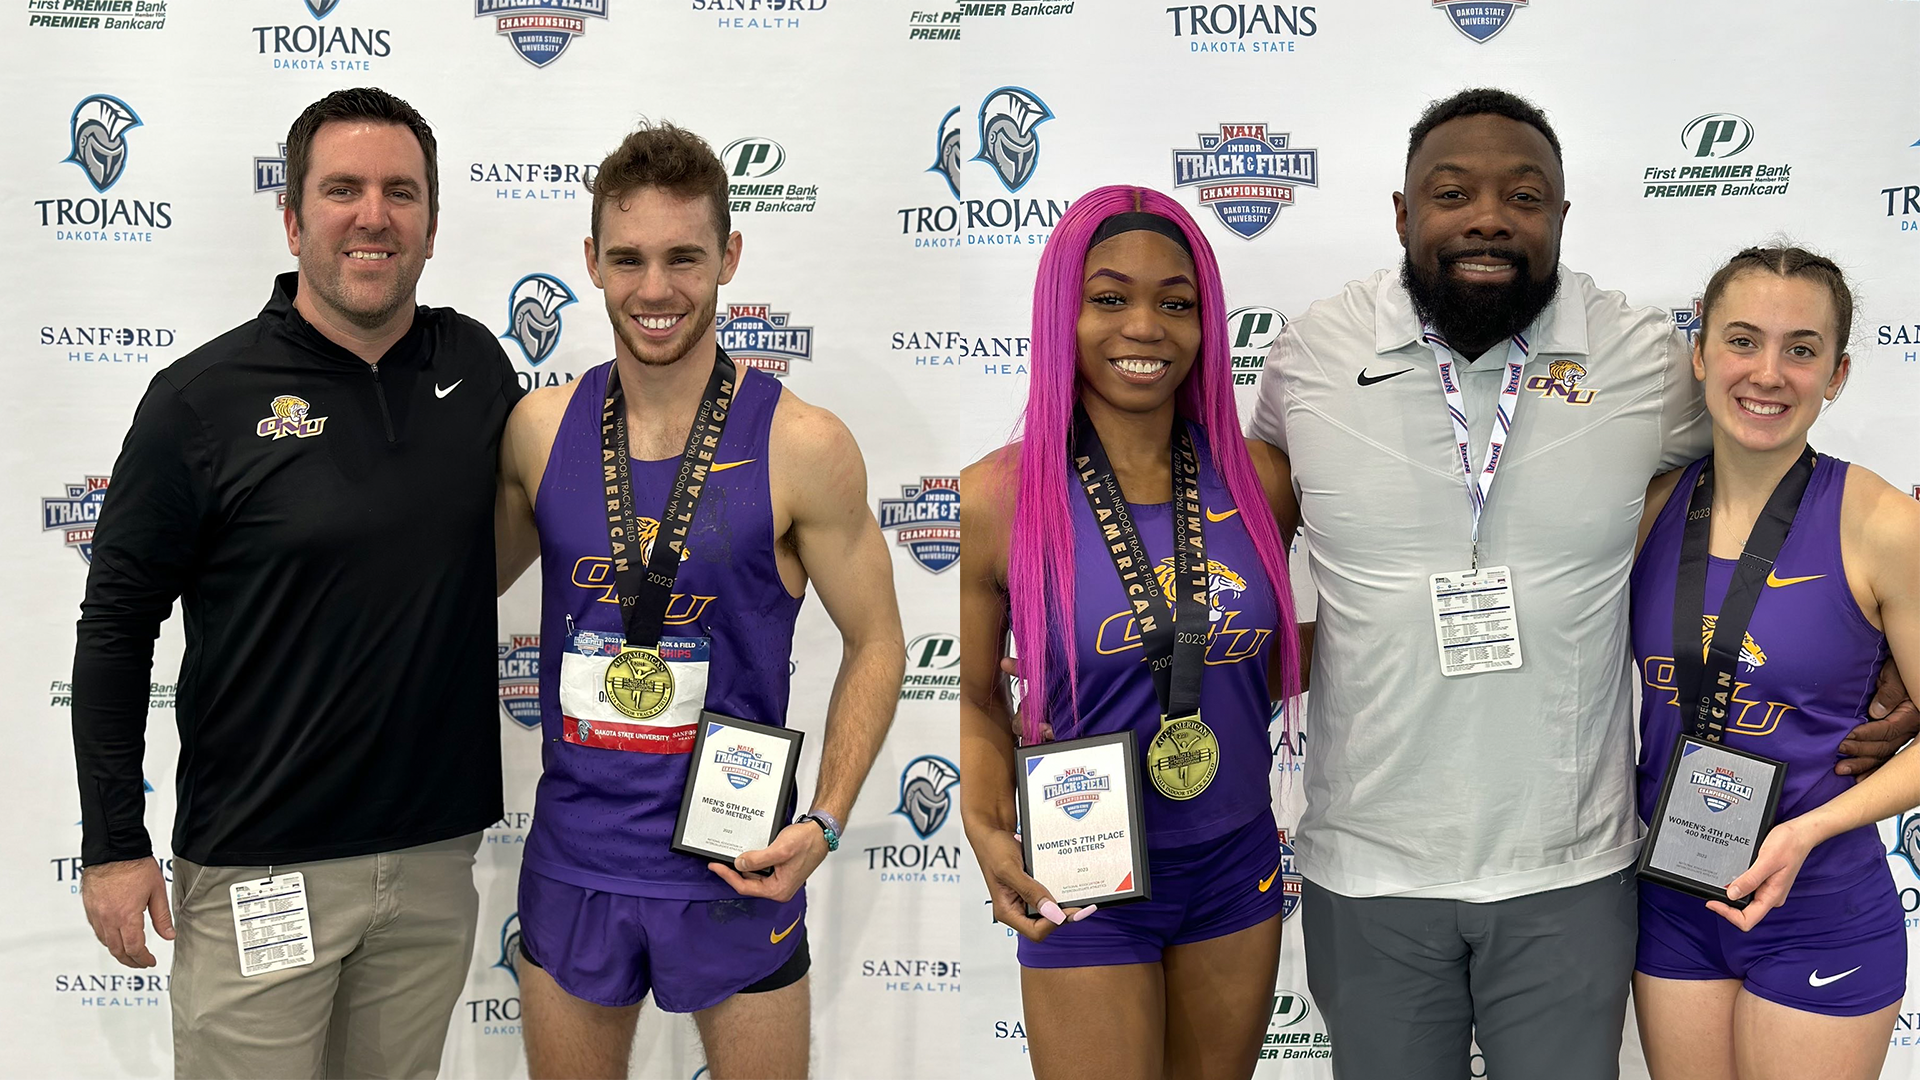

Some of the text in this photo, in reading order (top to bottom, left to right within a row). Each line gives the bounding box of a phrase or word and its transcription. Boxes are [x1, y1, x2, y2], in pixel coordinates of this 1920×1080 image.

[28, 0, 167, 12] First PREMIER Bank
[1011, 2, 1075, 16] Bankcard
[1456, 8, 1505, 17] DAKOTA STATE
[29, 15, 165, 29] PREMIER Bankcard
[500, 17, 581, 29] CHAMPIONSHIPS
[718, 18, 799, 28] HEALTH
[910, 11, 939, 23] First
[1166, 4, 1318, 39] TROJANS
[1460, 17, 1501, 26] UNIVERSITY
[252, 25, 391, 57] TROJANS
[544, 36, 563, 44] STATE
[1191, 41, 1295, 52] DAKOTA STATE
[522, 44, 559, 52] UNIVERSITY
[274, 59, 370, 70] DAKOTA STATE
[1222, 125, 1266, 142] NAIA
[1227, 144, 1262, 153] INDOOR
[1178, 153, 1312, 181] TRACK & FIELD
[1643, 164, 1792, 179] First PREMIER Bank
[496, 189, 576, 199] HEALTH
[786, 184, 819, 196] Bank
[1202, 186, 1291, 200] CHAMPIONSHIPS
[1644, 182, 1789, 198] PREMIER Bankcard
[34, 198, 172, 229] TROJANS
[755, 201, 816, 212] Bankcard
[1223, 206, 1271, 215] DAKOTA STATE
[897, 206, 960, 236] TRO
[1227, 214, 1268, 223] UNIVERSITY
[57, 231, 152, 241] DAKOTA STATE
[915, 238, 960, 248] DAKOTA
[968, 234, 1021, 245] DAKOTA
[730, 306, 767, 320] NAIA
[733, 322, 763, 330] INDOOR
[40, 326, 174, 347] SANFORD
[749, 331, 807, 355] & FIELD
[69, 352, 149, 363] HEALTH
[1439, 361, 1459, 394] NAIA
[1502, 362, 1523, 395] NAIA
[1524, 374, 1601, 406] ONU
[257, 413, 328, 440] ONU
[618, 442, 628, 478] INDOOR
[666, 499, 679, 521] NAIA
[674, 460, 693, 499] INDOOR
[686, 432, 703, 460] TRACK
[699, 400, 712, 423] FIELD
[1483, 442, 1502, 473] NAIA
[669, 379, 733, 554] ALL-AMERICAN
[602, 398, 629, 572] ALL-AMERICAN
[922, 479, 960, 492] NAIA
[621, 478, 631, 508] TRACK
[1176, 484, 1185, 513] TRACK
[882, 502, 948, 525] TRACK &
[1689, 507, 1711, 521] 2023
[626, 518, 636, 542] FIELD
[1102, 473, 1117, 497] NAIA
[1112, 497, 1134, 534] INDOOR
[1127, 534, 1146, 564] TRACK
[1142, 573, 1159, 598] FIELD
[1175, 515, 1186, 552] INDOOR
[1075, 455, 1158, 634] ALL-AMERICAN
[1179, 554, 1188, 574] NAIA
[647, 572, 674, 588] 2023
[1177, 632, 1207, 645] 2023
[532, 661, 539, 674] &
[1699, 696, 1710, 721] FIELD
[594, 729, 617, 737] DAKOTA
[635, 733, 670, 741] UNIVERSITY
[737, 745, 755, 754] NAIA
[716, 751, 772, 774] TRACK FIELD
[1065, 767, 1085, 777] NAIA
[1715, 767, 1734, 777] NAIA
[1044, 777, 1108, 798] TRACK FIELD
[1692, 772, 1753, 799] TRACK FIELD
[702, 796, 765, 818] MEN'S 6TH PLACE
[711, 806, 752, 821] 800 METERS
[1669, 815, 1750, 846] WOMEN'S 4TH PLACE
[1037, 830, 1125, 851] WOMEN'S 7TH PLACE
[1685, 829, 1729, 847] 400 METERS
[1074, 842, 1105, 852] METERS
[880, 873, 927, 882] DAKOTA
[886, 982, 960, 992] HEALTH
[82, 997, 158, 1006] HEALTH
